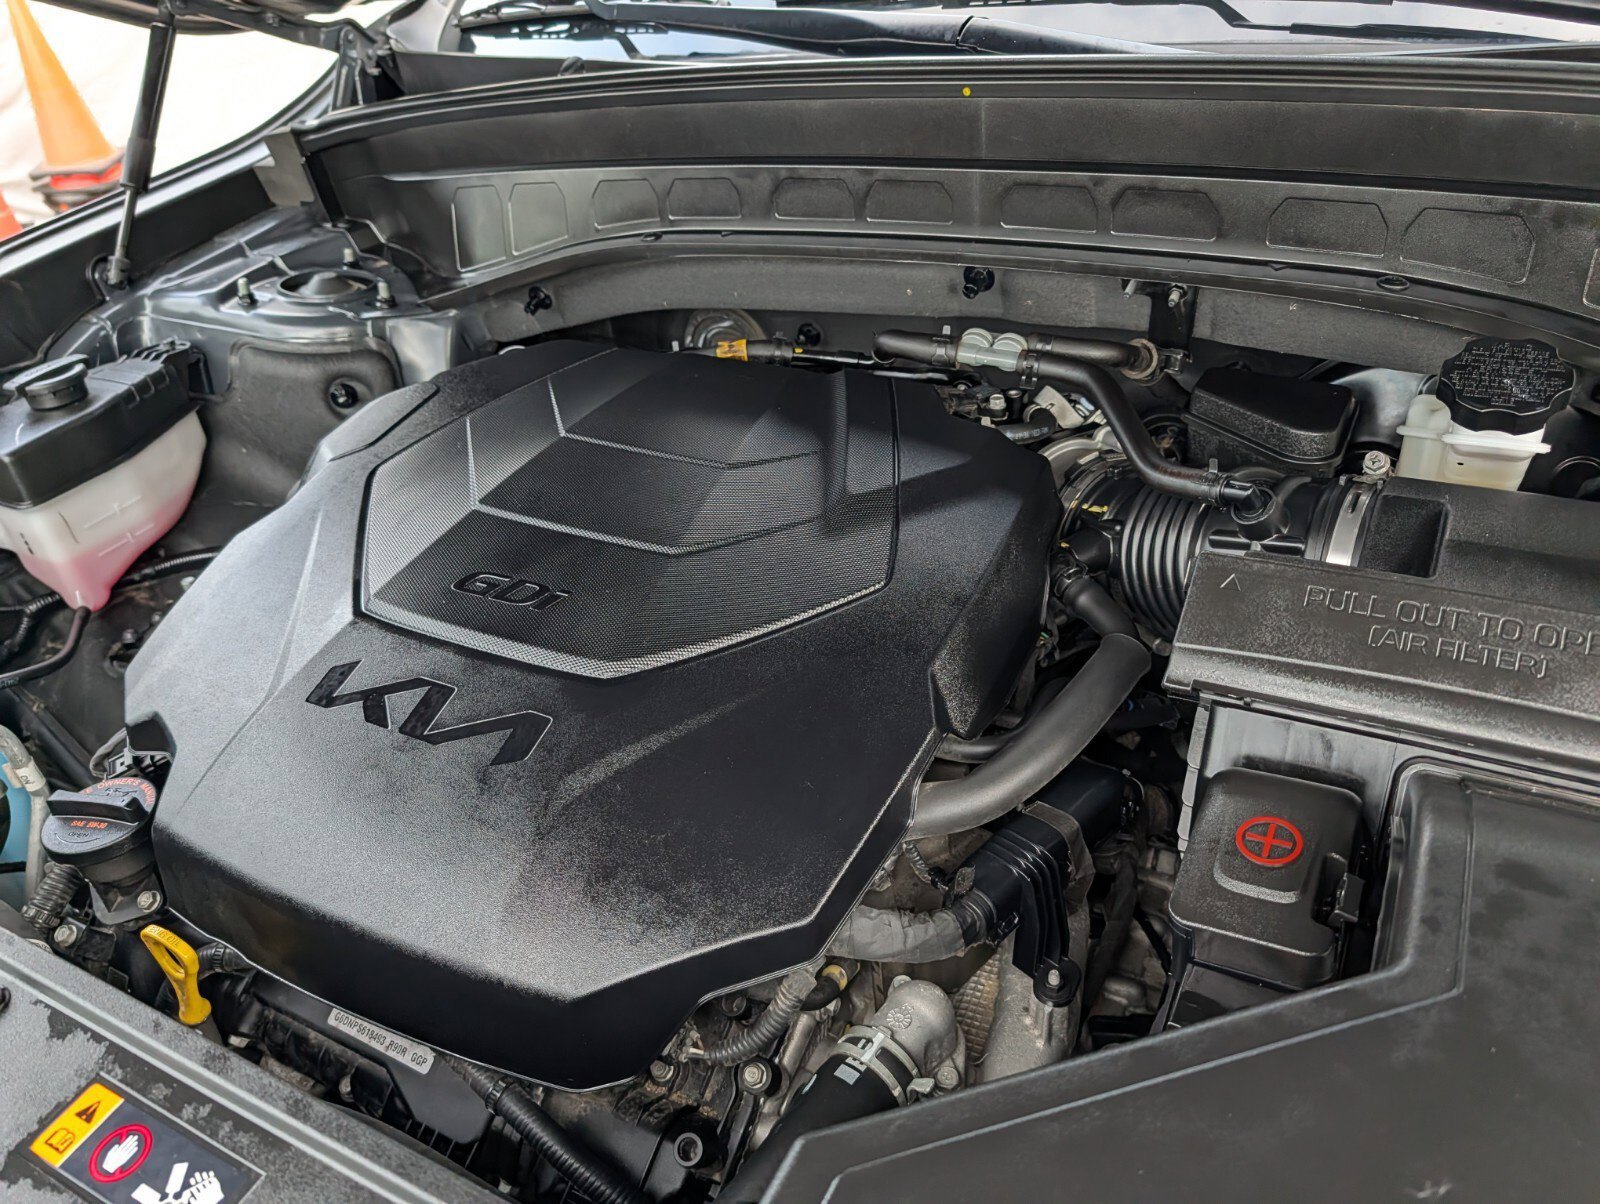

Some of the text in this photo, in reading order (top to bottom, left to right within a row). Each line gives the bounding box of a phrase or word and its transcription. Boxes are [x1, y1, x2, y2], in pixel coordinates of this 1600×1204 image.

[1303, 584, 1386, 619] PULL
[1396, 600, 1470, 633] OUT
[1478, 612, 1524, 643] TO
[305, 659, 553, 766] KIA
[97, 778, 141, 789] OWNER'S
